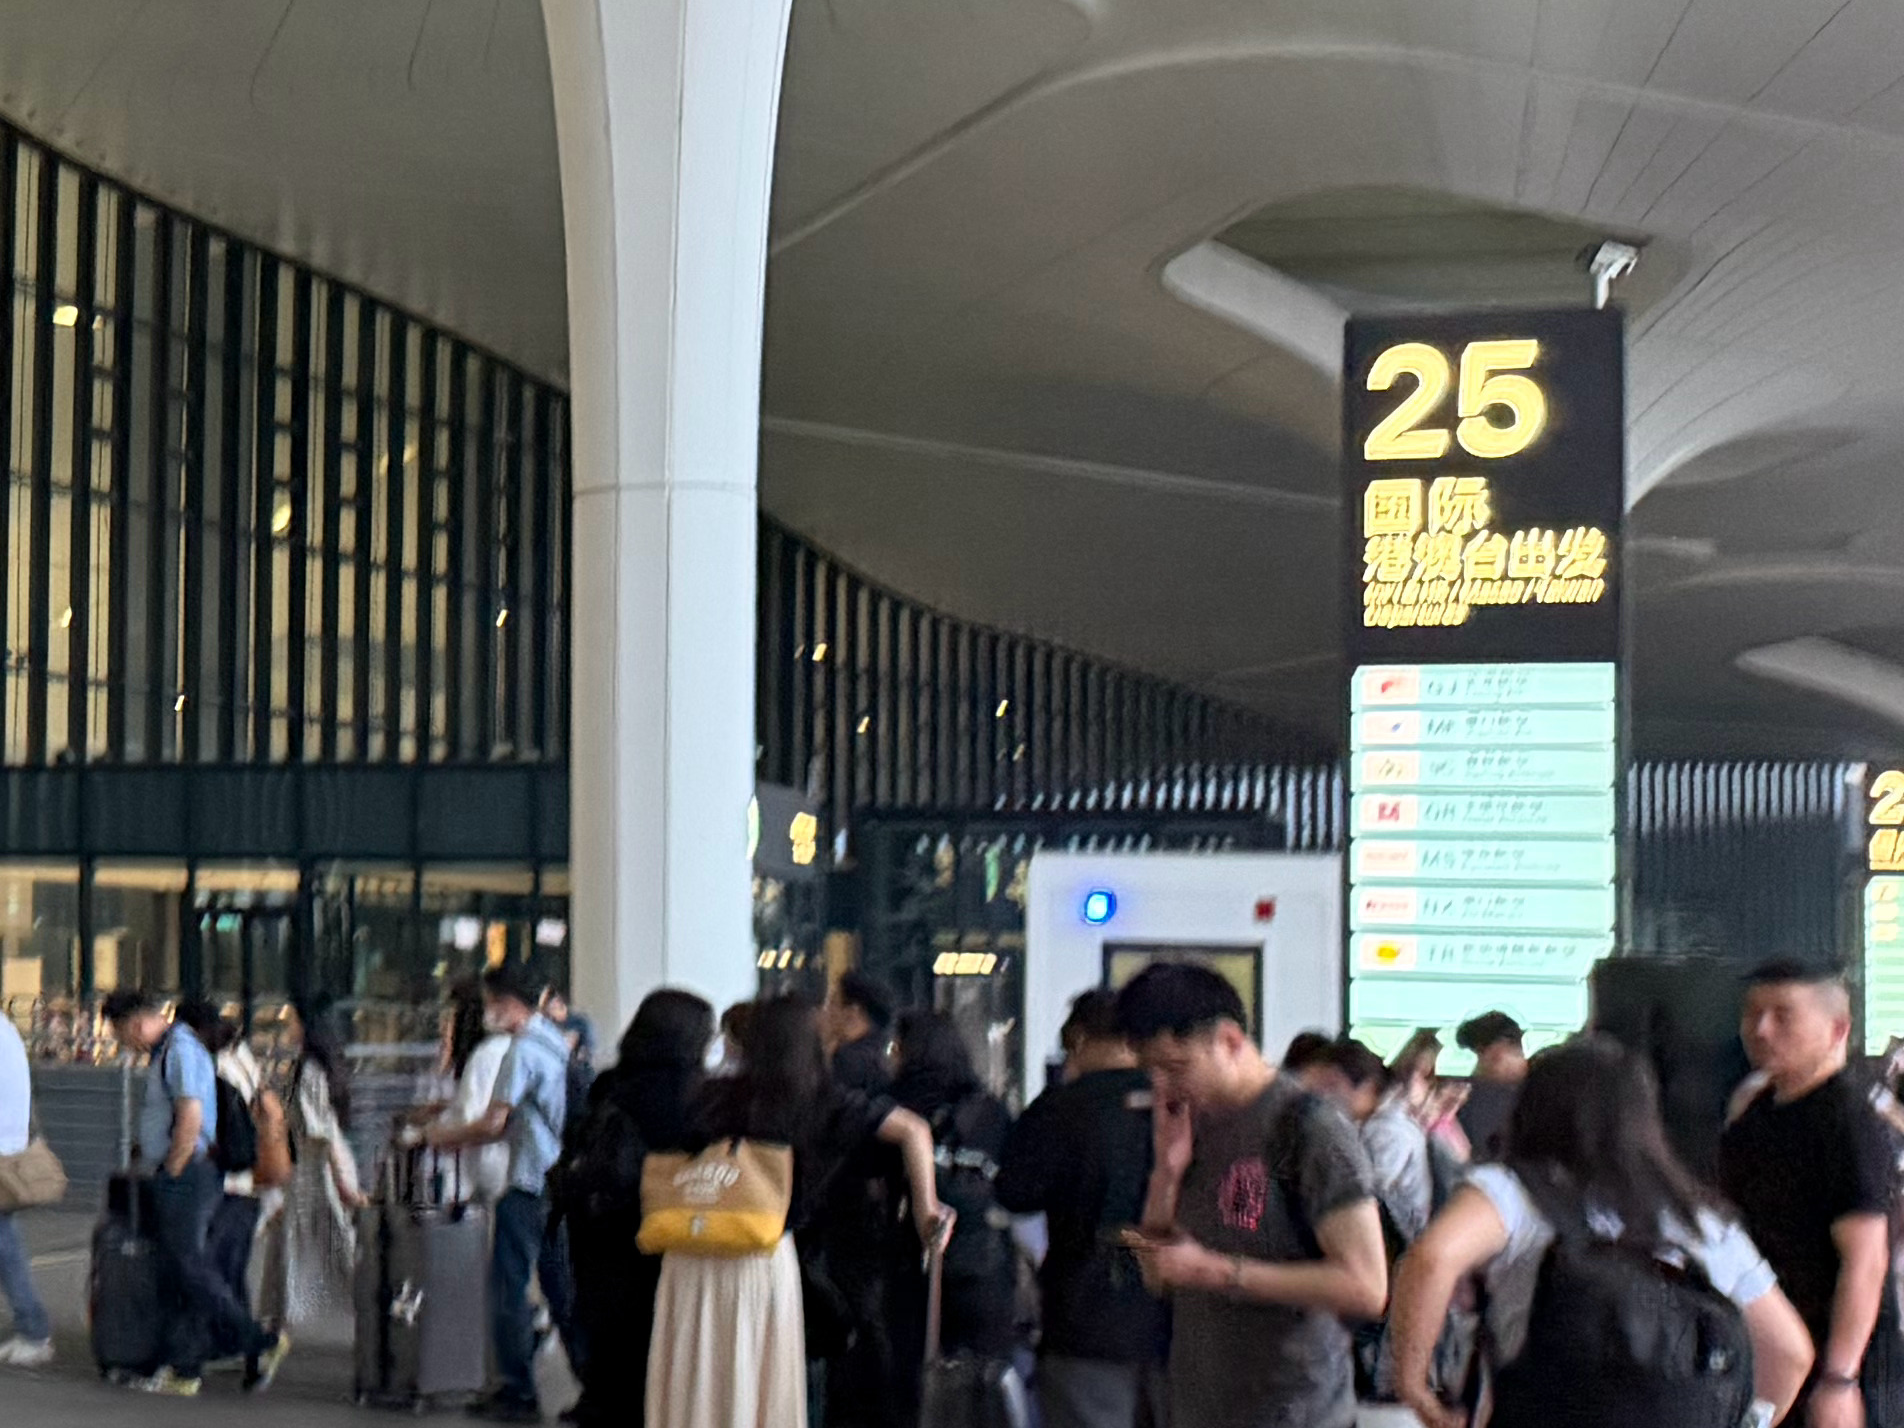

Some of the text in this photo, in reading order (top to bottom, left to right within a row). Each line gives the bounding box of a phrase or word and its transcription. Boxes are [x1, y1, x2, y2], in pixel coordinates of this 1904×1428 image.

[1363, 338, 1548, 461] 25
[1363, 476, 1493, 539] 国际
[1363, 527, 1609, 583] 港澳台出发
